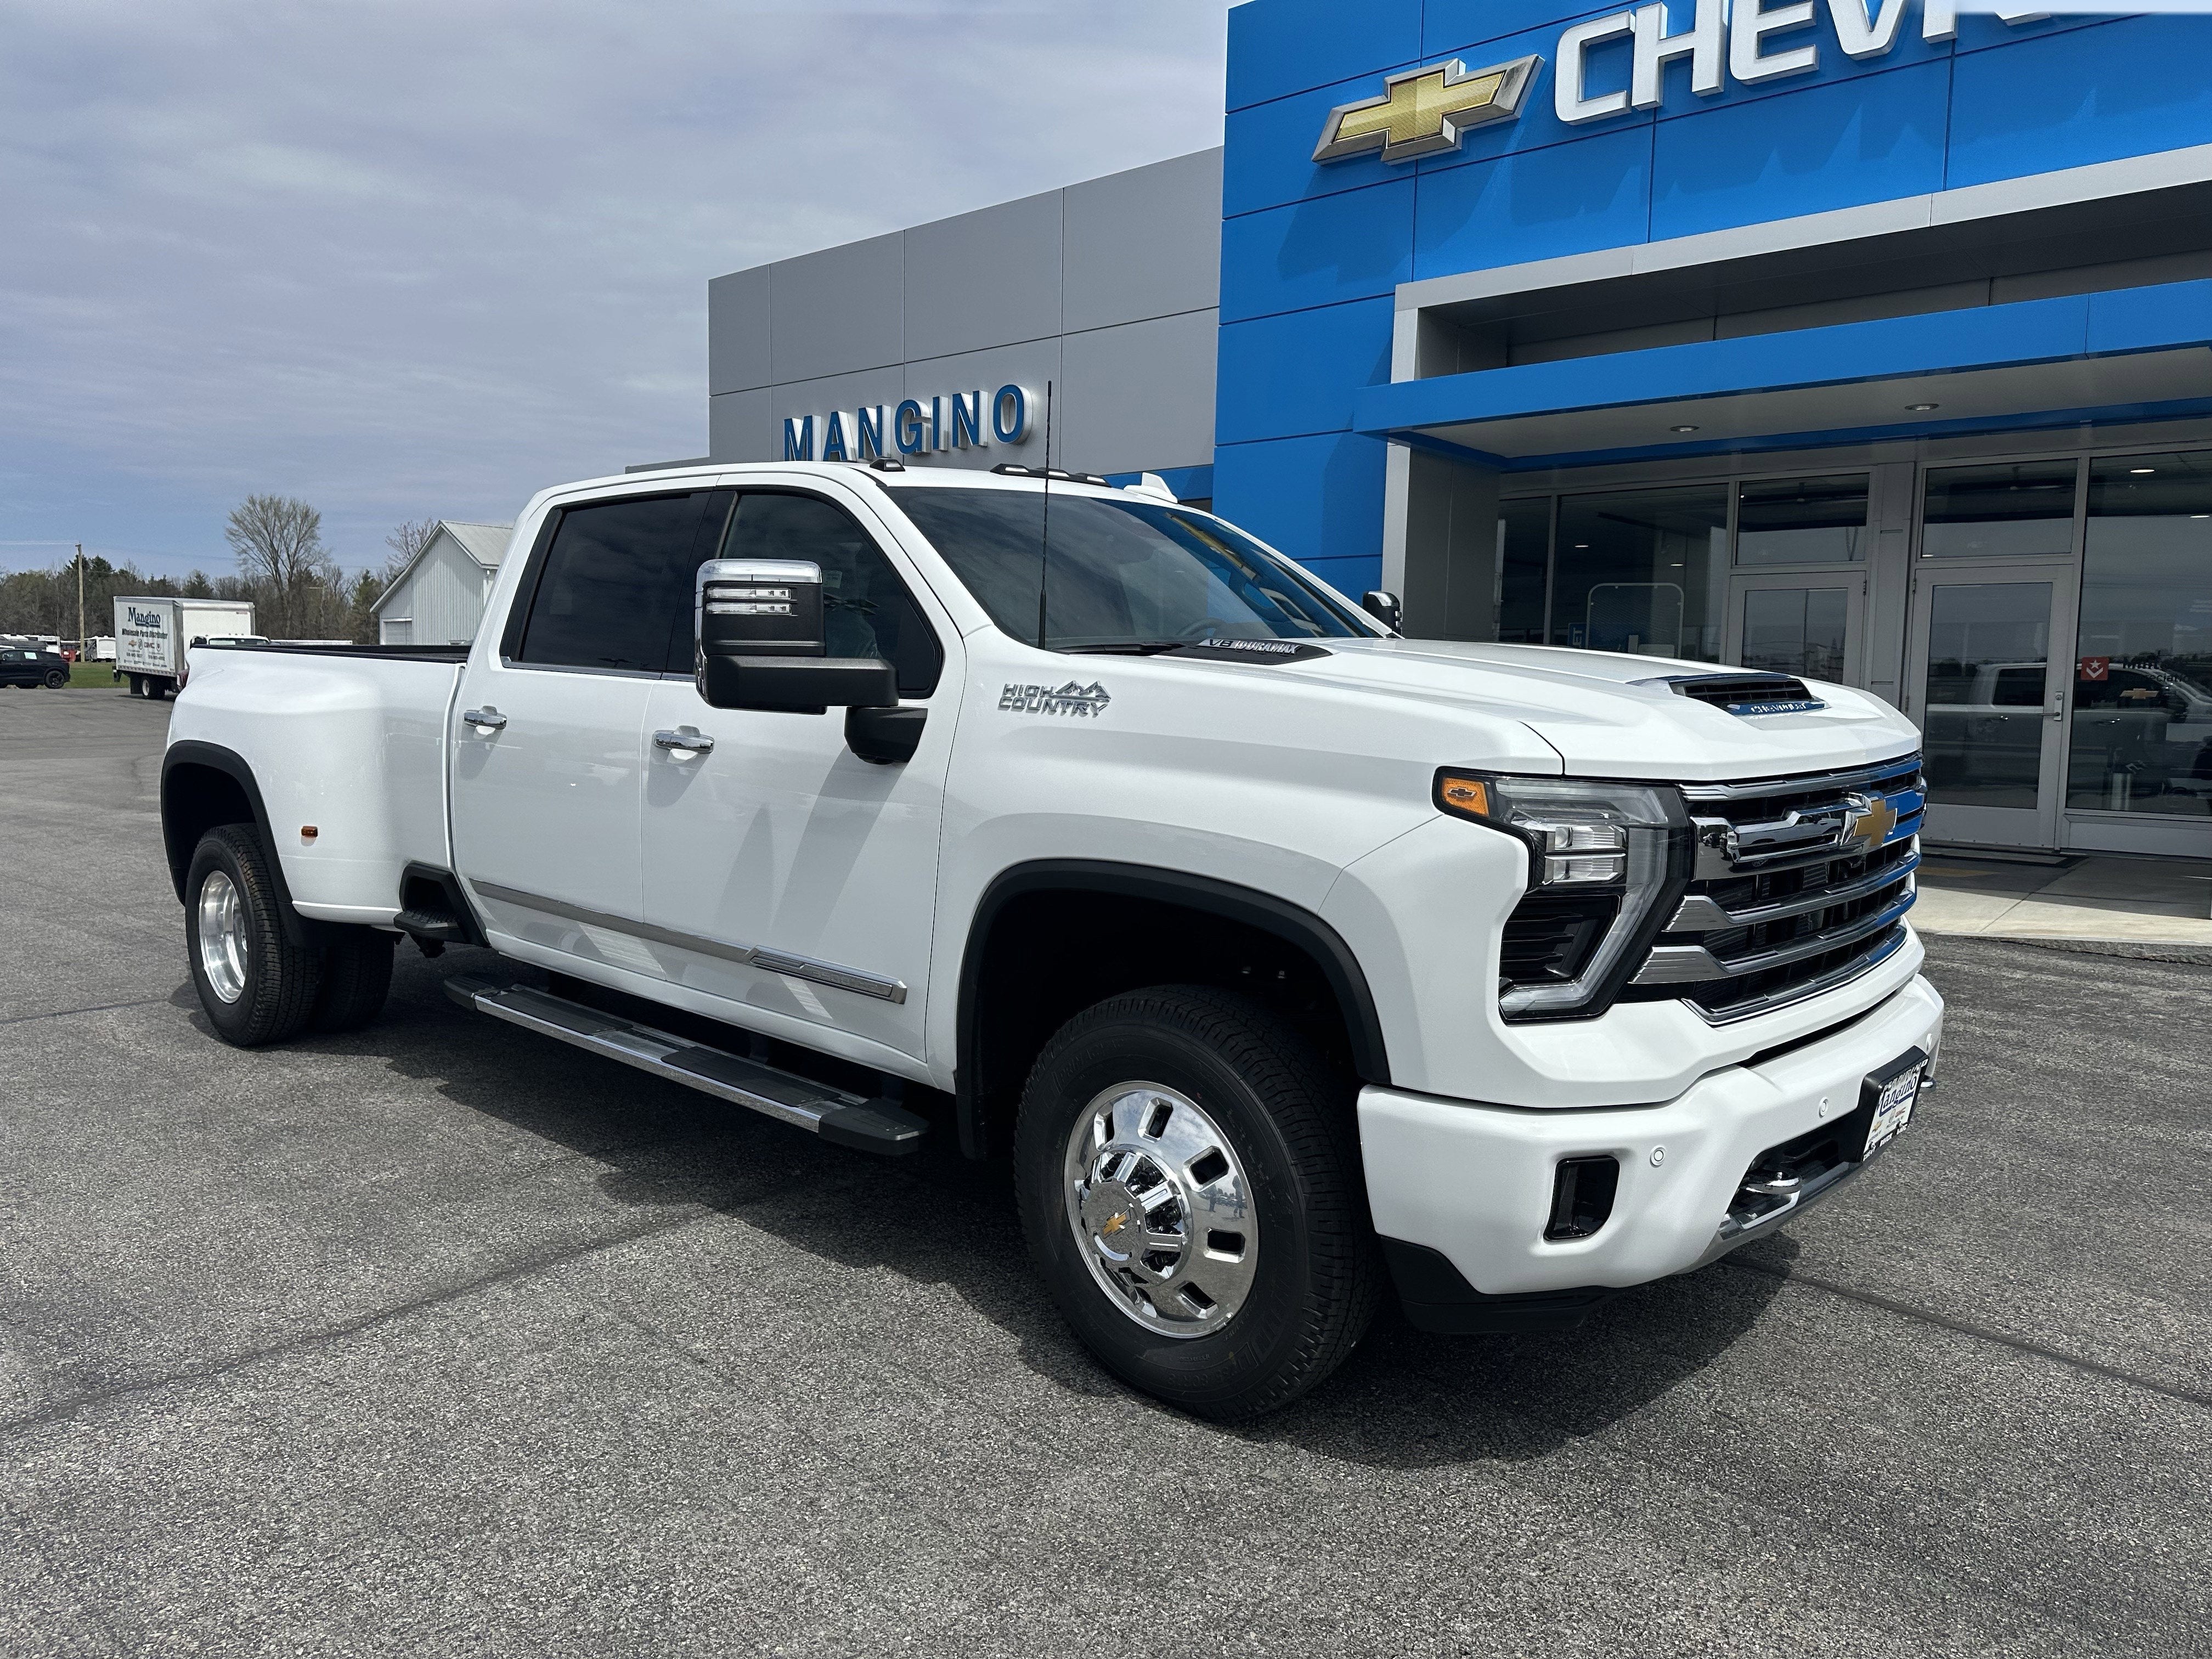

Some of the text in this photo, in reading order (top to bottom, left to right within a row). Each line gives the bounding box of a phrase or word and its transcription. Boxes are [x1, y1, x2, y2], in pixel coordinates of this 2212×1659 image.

[783, 384, 1032, 462] MANGINO
[128, 607, 160, 628] Mangino
[1209, 639, 1234, 647] V8
[1002, 684, 1055, 696] HIGH
[998, 696, 1108, 717] COUNTRY
